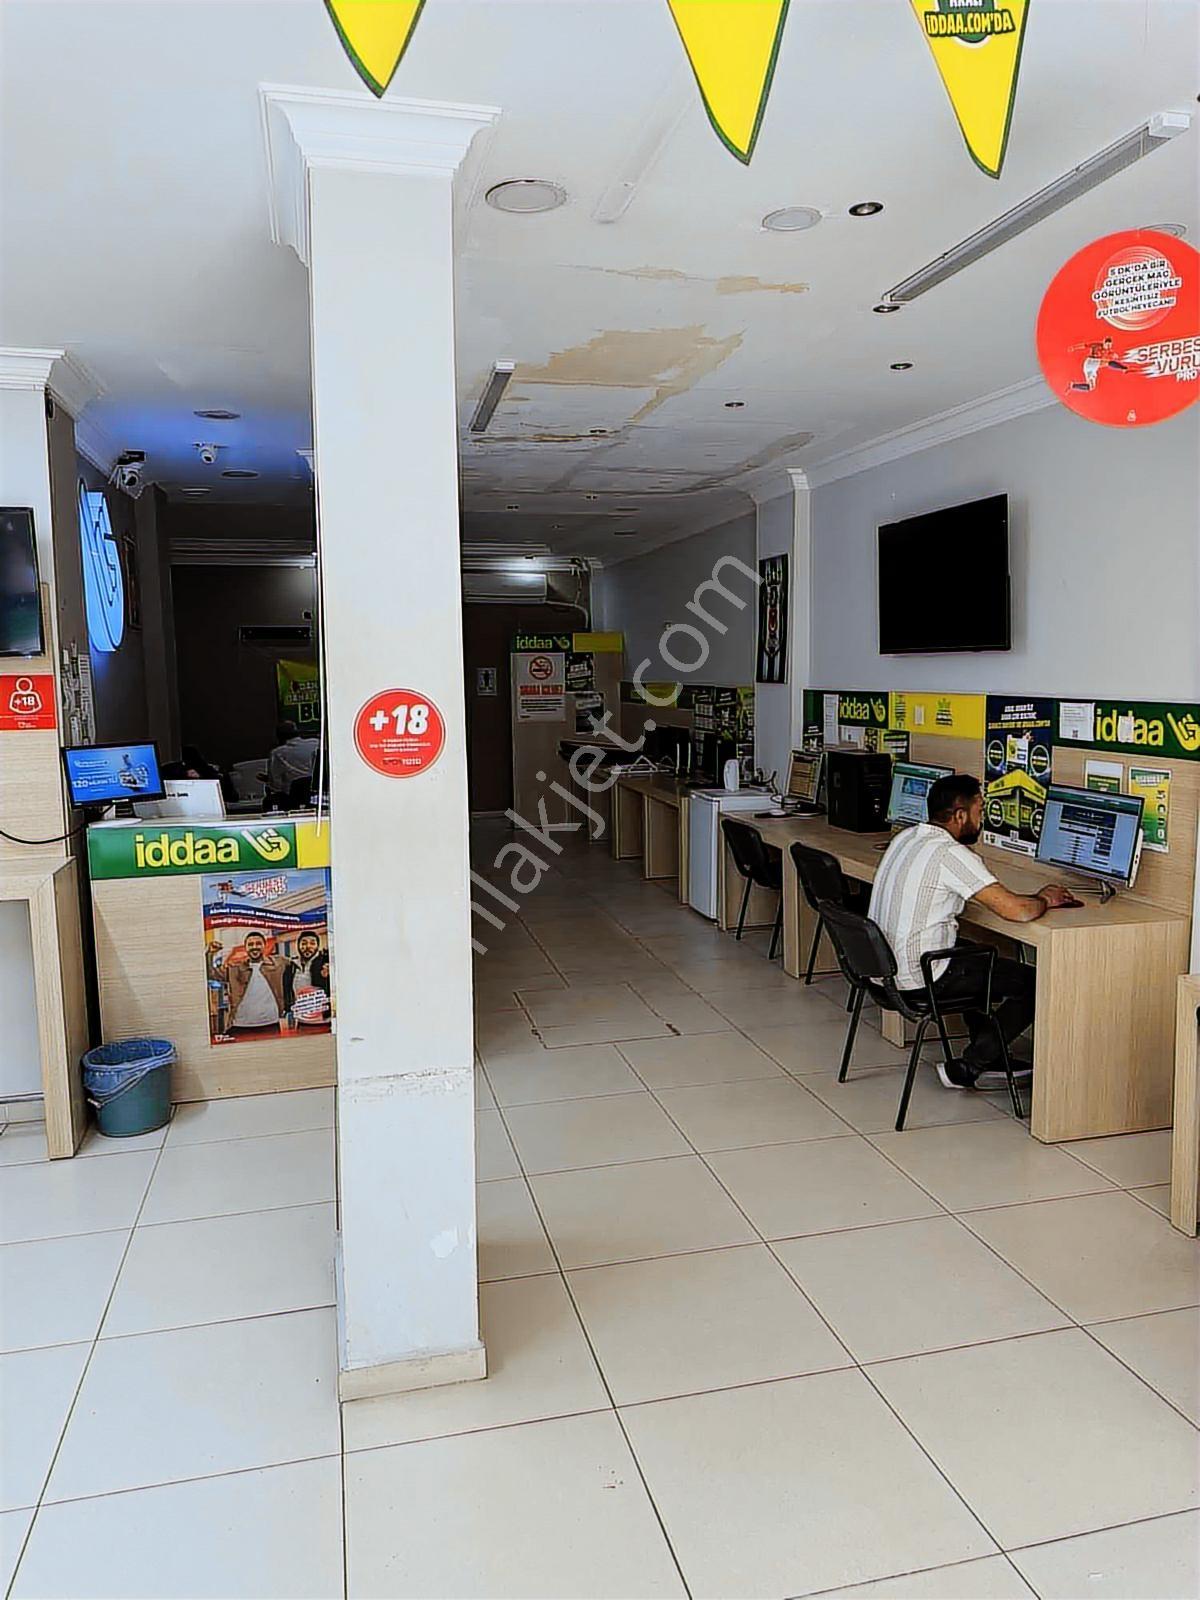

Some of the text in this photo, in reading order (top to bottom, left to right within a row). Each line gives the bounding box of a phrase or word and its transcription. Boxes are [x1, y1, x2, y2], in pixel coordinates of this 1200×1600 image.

[516, 635, 553, 650] iddaa
[368, 703, 430, 736] +18
[838, 697, 870, 721] iddaa
[135, 831, 240, 869] iddaa
